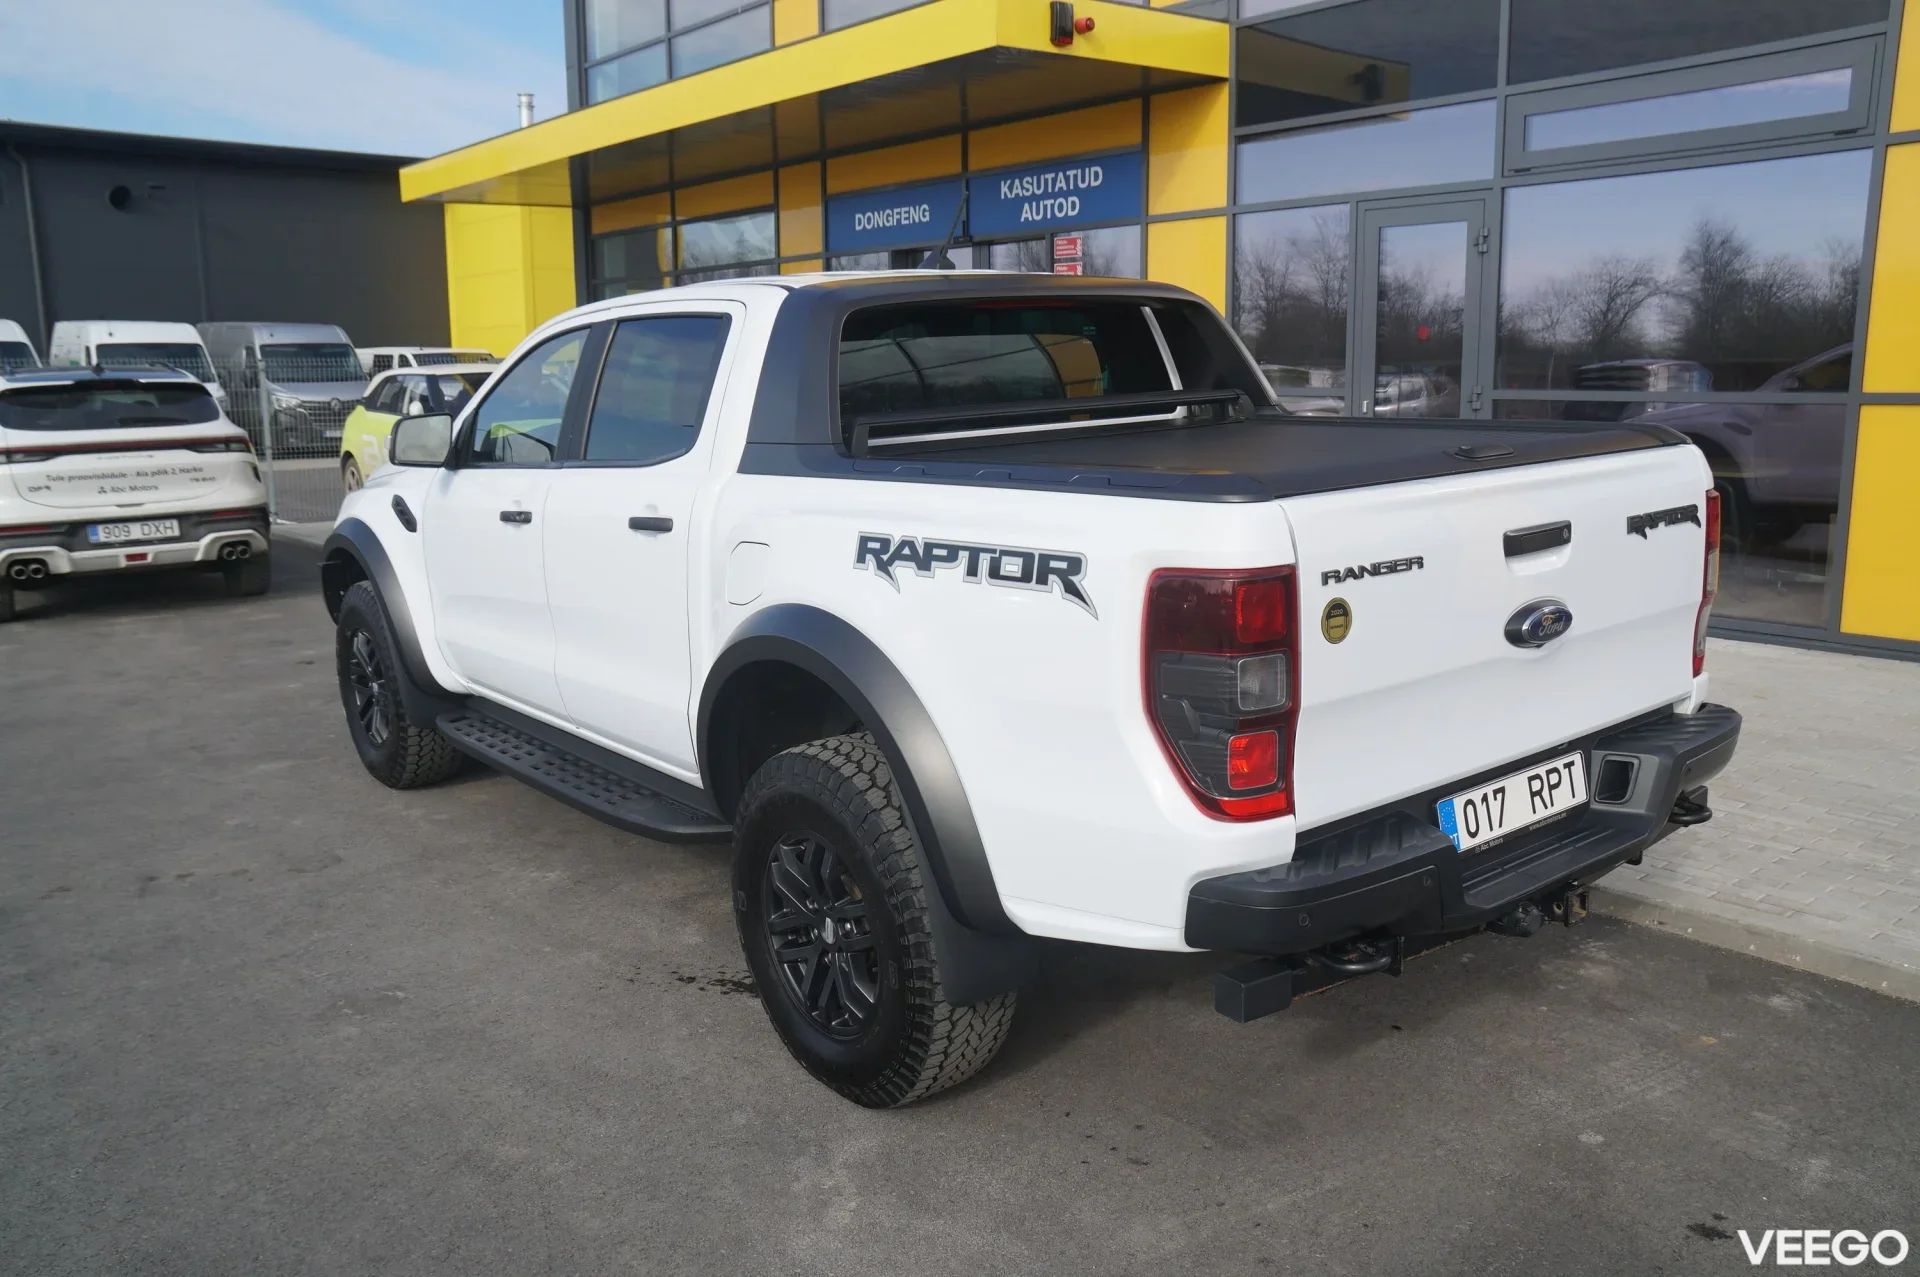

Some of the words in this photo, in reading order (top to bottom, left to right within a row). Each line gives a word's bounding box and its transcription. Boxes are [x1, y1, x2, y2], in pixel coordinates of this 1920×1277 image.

[1000, 165, 1103, 200] KASUTATUD
[854, 203, 930, 231] DONGFENG
[1020, 196, 1080, 222] AUTOD
[103, 525, 131, 539] 909
[141, 522, 174, 537] DXH
[1627, 504, 1701, 540] RAPTOR
[853, 531, 1099, 621] RAPTOR
[1321, 555, 1424, 587] RANGER
[1330, 608, 1344, 616] 2020
[1538, 613, 1566, 637] Ford
[1462, 785, 1506, 839] 017
[1527, 760, 1576, 815] RPT
[1529, 812, 1567, 832] www.abcmotors.ee
[1480, 843, 1490, 852] Abc
[1489, 837, 1504, 848] Motors
